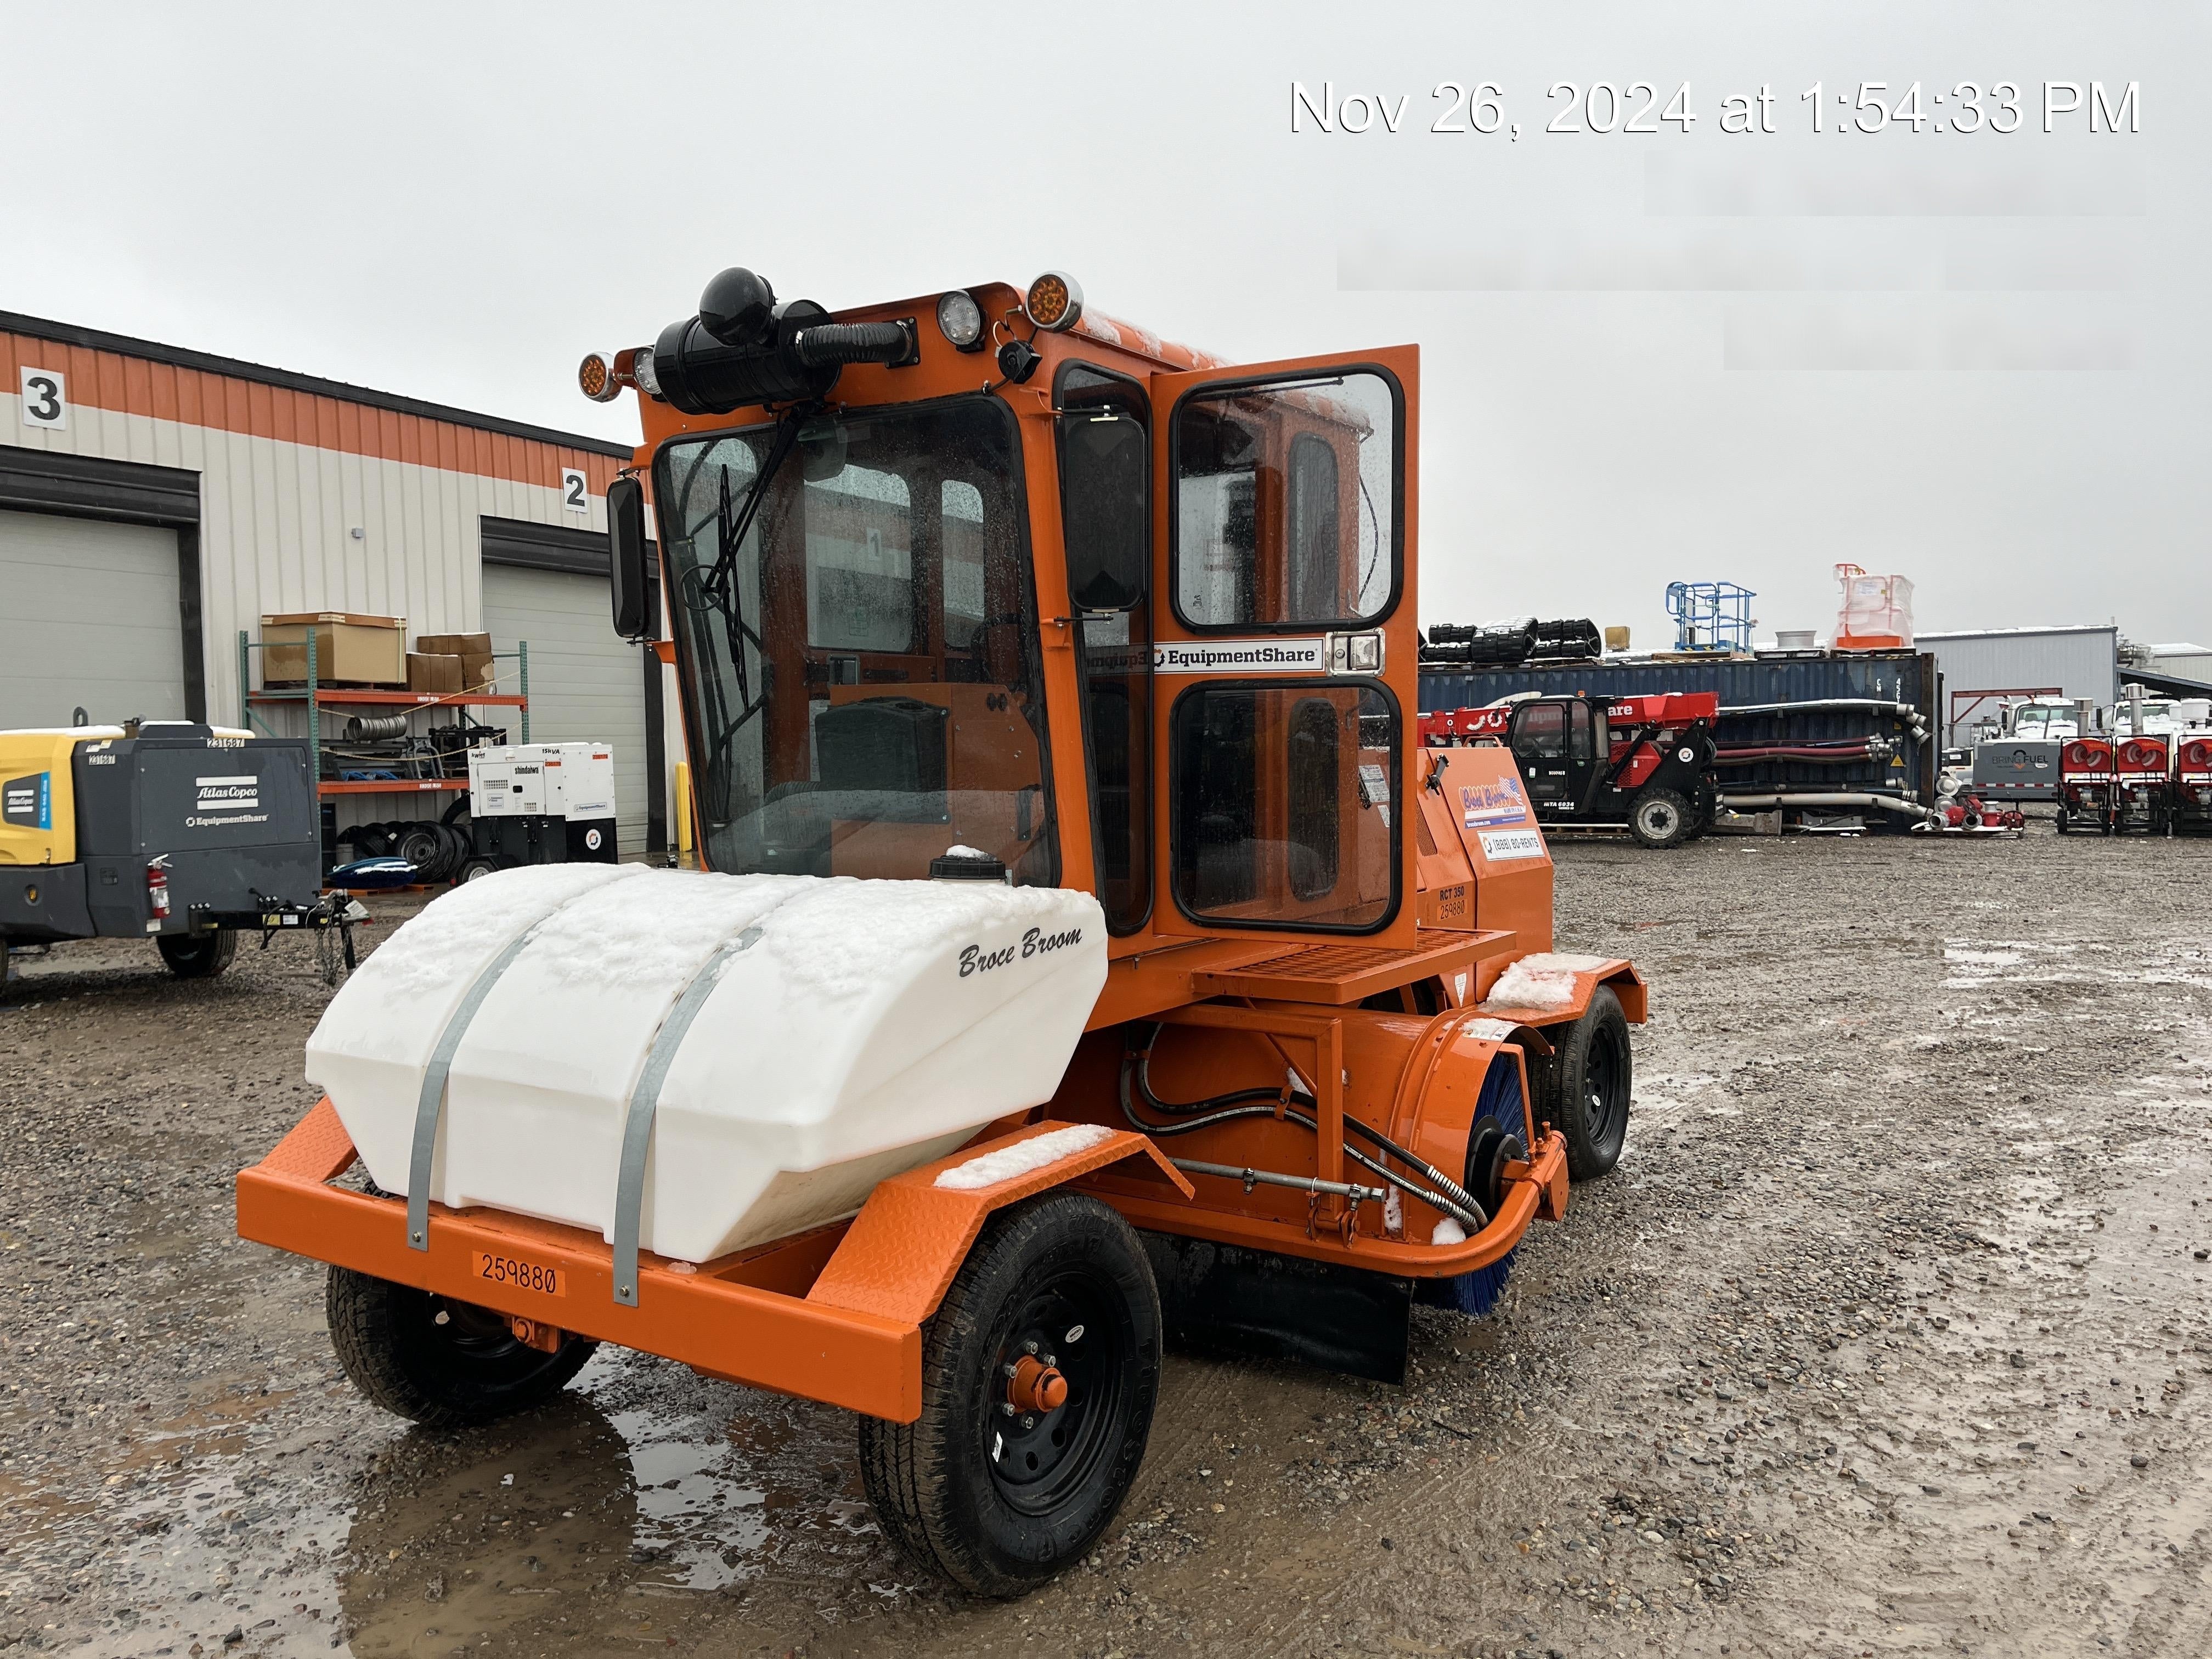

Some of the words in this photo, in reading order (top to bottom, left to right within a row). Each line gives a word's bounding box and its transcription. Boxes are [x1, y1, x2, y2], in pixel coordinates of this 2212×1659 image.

[27, 377, 61, 420] 3
[565, 475, 585, 507] 2
[1168, 648, 1315, 667] EquipmentShare
[208, 738, 243, 748] 231687
[1993, 755, 2021, 764] BRING
[2023, 755, 2049, 763] FUEL
[515, 765, 539, 775] shindaiwa
[196, 787, 228, 799] Atlas
[228, 786, 258, 799] Copco
[196, 814, 268, 827] EquipmentShare
[1492, 838, 1512, 851] (888)
[1440, 888, 1452, 901] RCT
[1454, 885, 1464, 898] 350
[1440, 900, 1465, 920] 259880
[958, 944, 1015, 978] Broce
[1022, 927, 1082, 958] Broom
[482, 1254, 556, 1294] 259880
